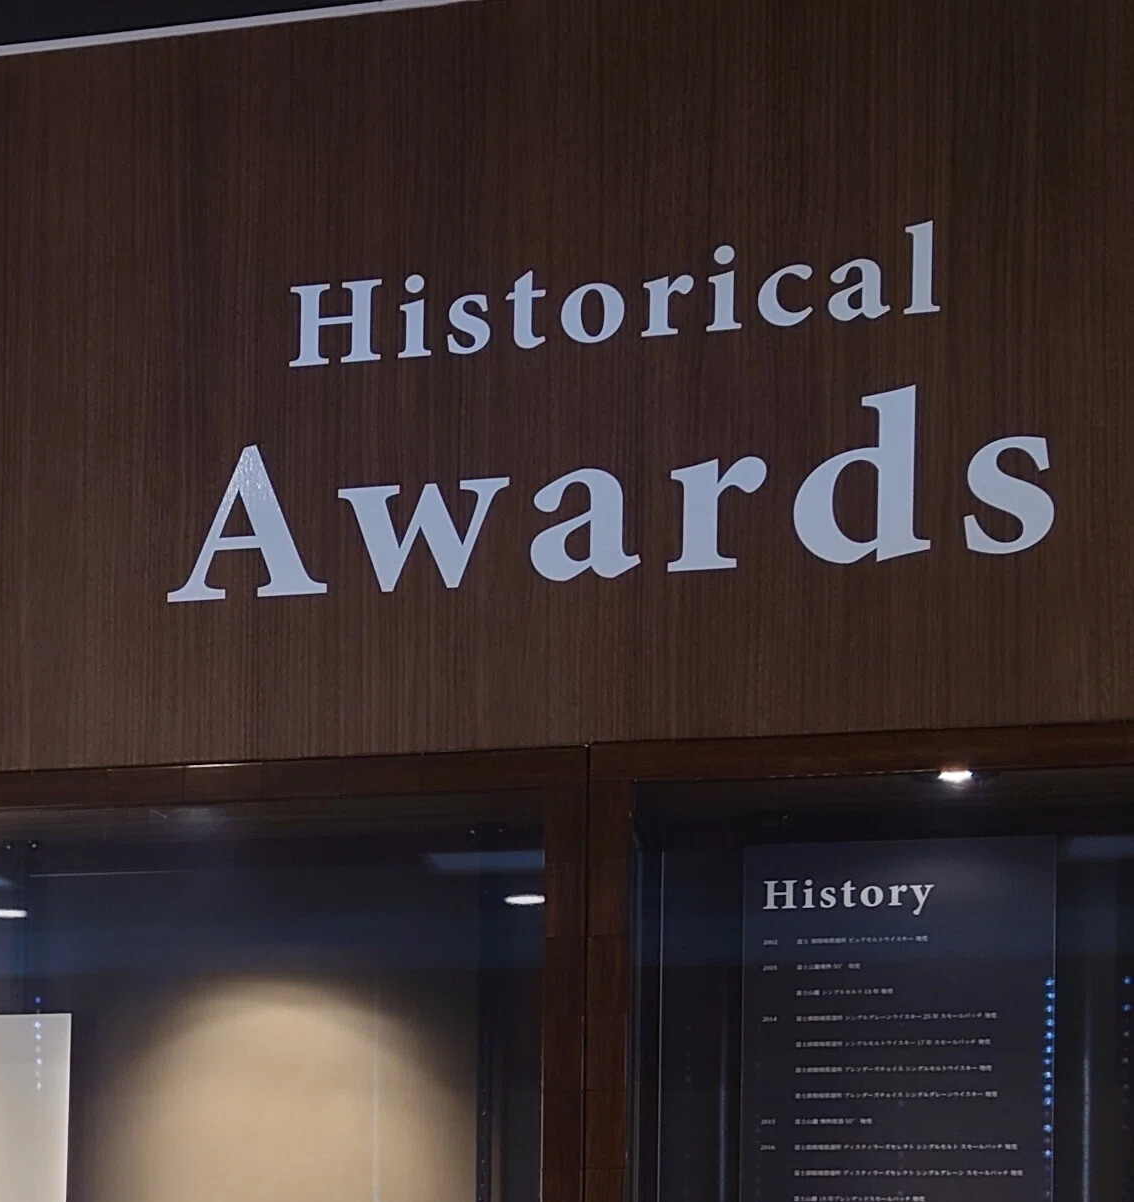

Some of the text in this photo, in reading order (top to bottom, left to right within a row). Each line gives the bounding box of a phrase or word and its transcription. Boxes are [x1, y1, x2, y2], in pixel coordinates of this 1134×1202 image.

[289, 219, 941, 368] Historical
[167, 385, 1056, 603] Awards
[763, 879, 934, 915] History
